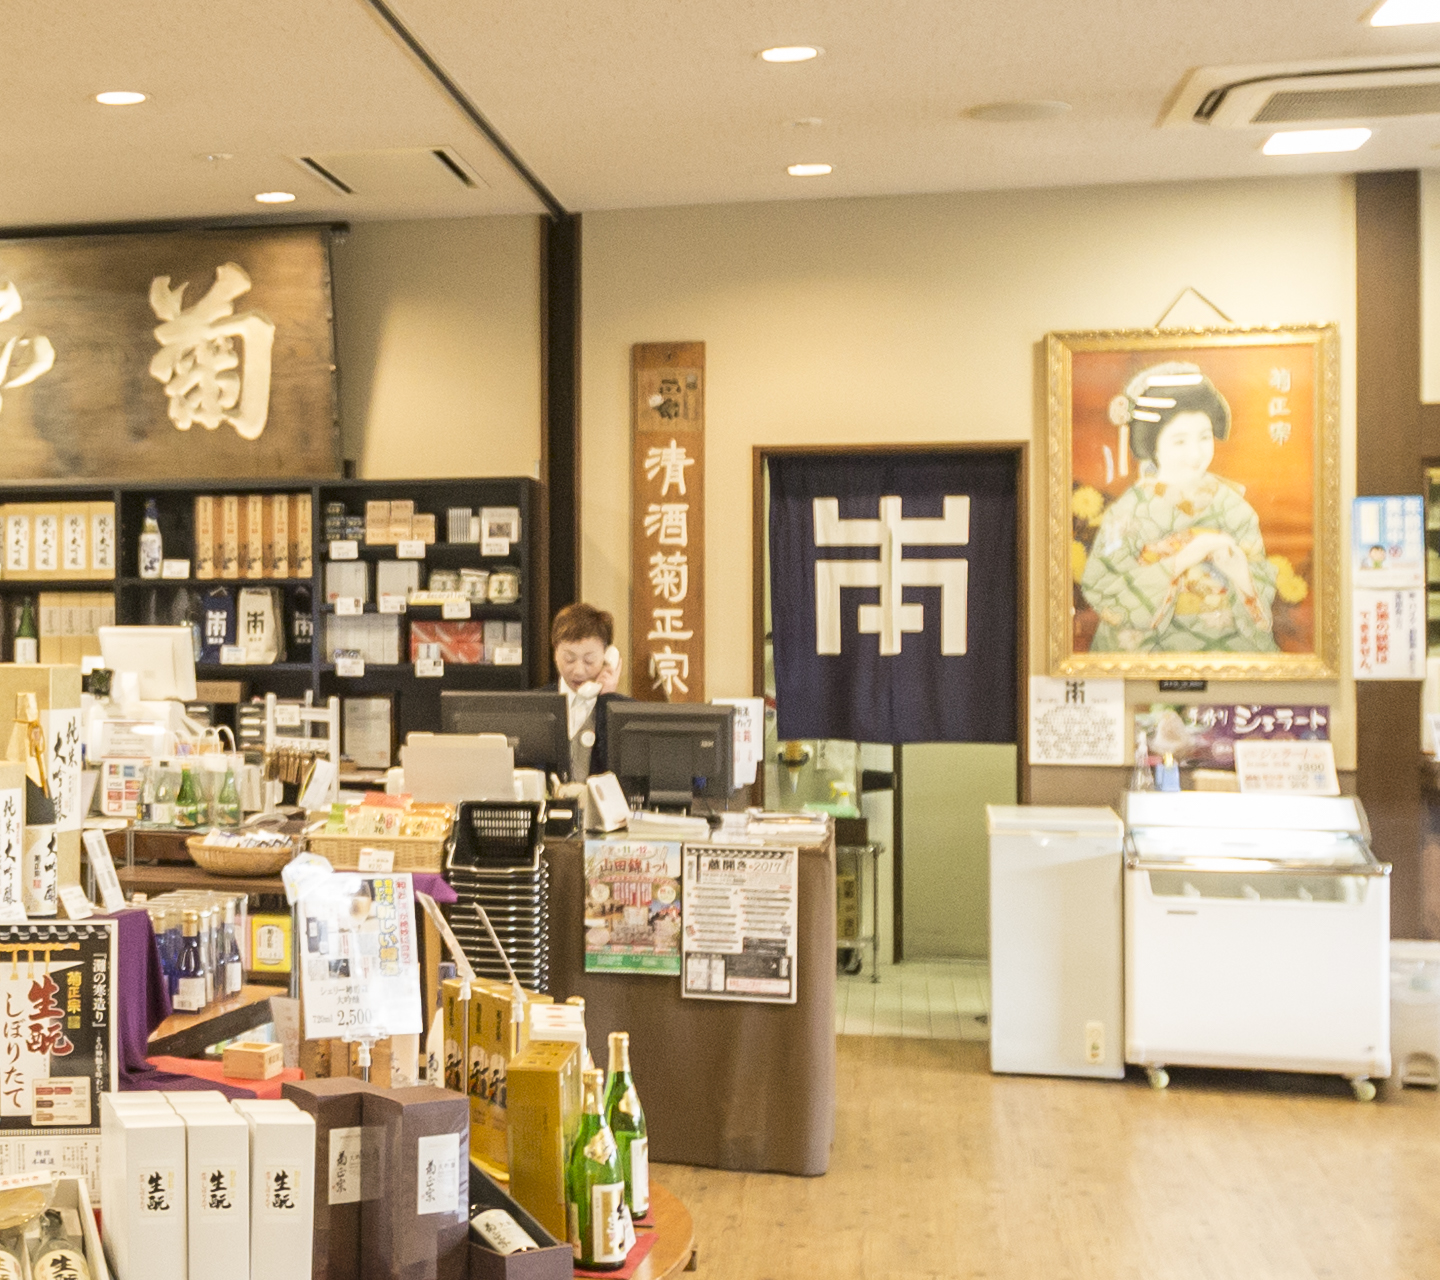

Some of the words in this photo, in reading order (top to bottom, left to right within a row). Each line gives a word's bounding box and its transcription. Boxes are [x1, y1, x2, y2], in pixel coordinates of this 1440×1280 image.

[1268, 366, 1293, 446] 菊正宗
[645, 438, 694, 695] 清酒菊正宗
[1234, 705, 1328, 734] ジェラート
[66, 971, 83, 1014] 菊正宗
[26, 974, 75, 1057] 生酛
[3, 991, 25, 1109] しぼりたて
[147, 1171, 171, 1212] 生酛
[209, 1169, 232, 1210] 生酛
[272, 1169, 296, 1210] 生酛
